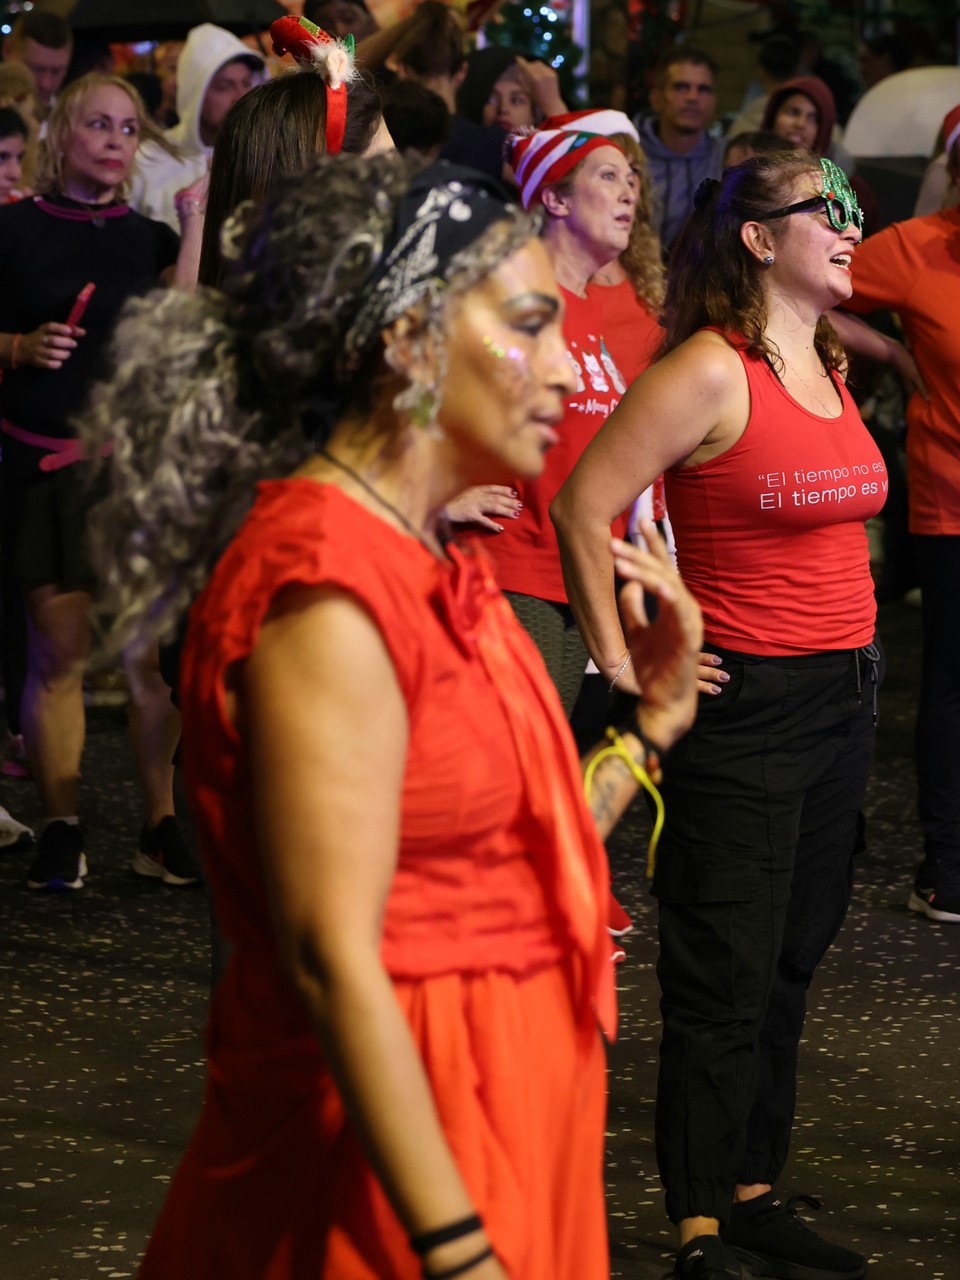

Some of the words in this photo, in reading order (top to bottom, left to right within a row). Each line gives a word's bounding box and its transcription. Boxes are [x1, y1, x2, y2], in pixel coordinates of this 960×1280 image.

[793, 469, 849, 483] tiempo
[852, 464, 869, 476] no
[871, 461, 884, 473] es
[760, 492, 782, 510] El
[791, 485, 856, 506] tiempo
[861, 482, 878, 495] es
